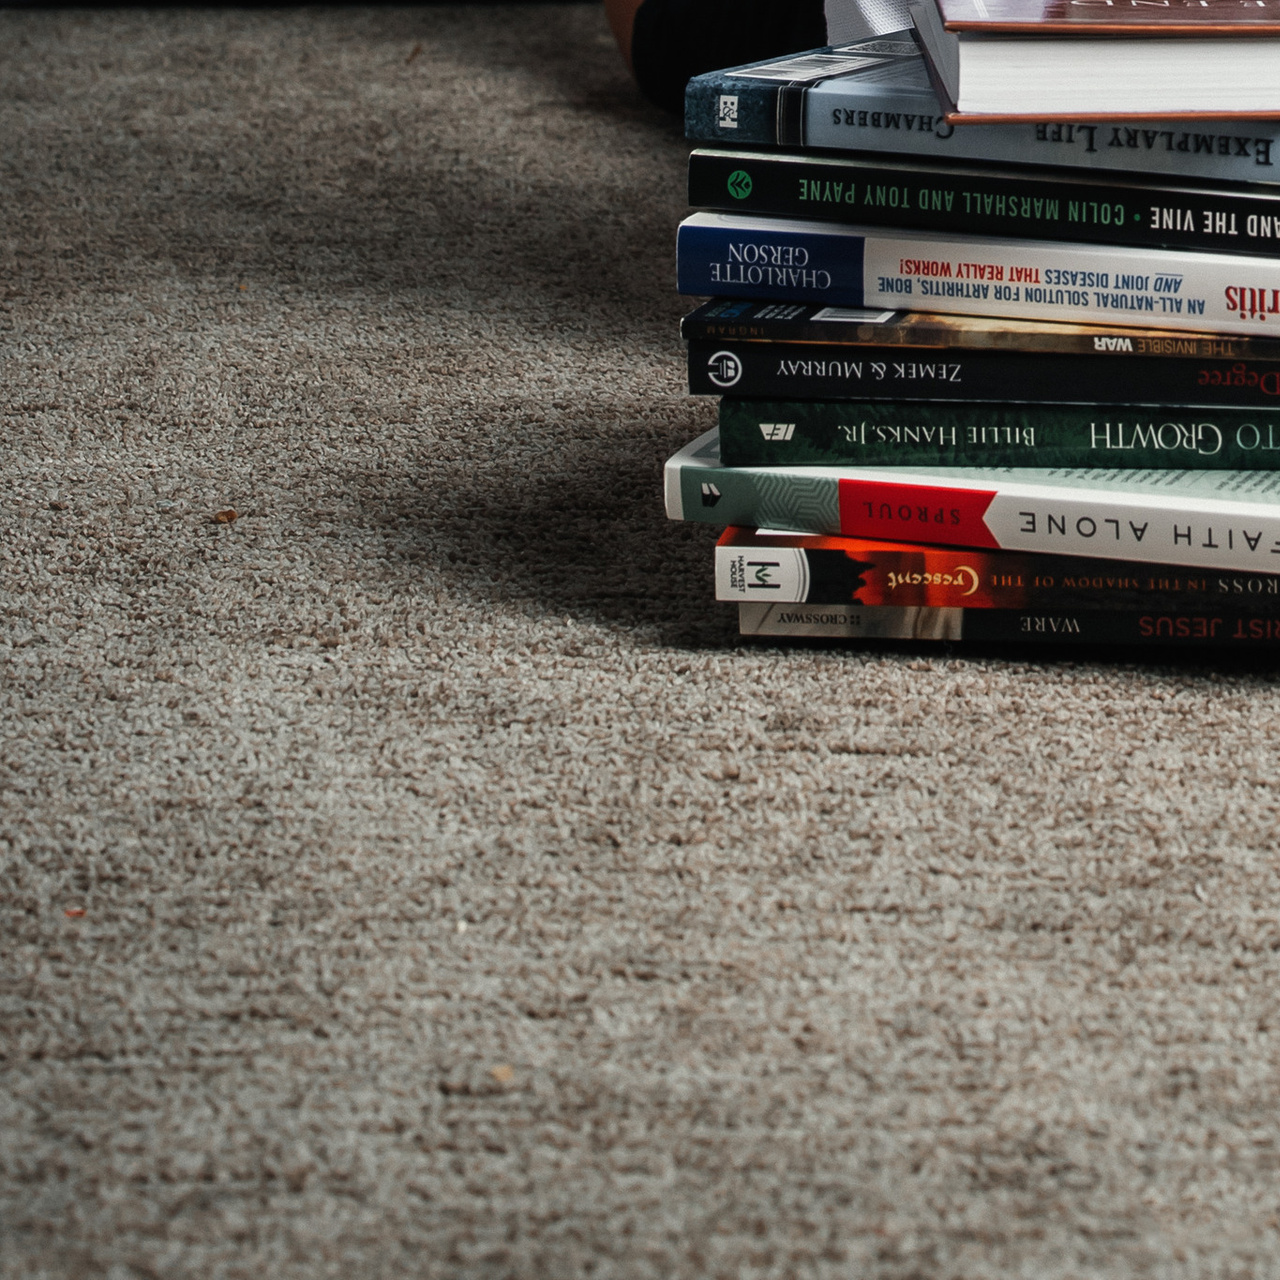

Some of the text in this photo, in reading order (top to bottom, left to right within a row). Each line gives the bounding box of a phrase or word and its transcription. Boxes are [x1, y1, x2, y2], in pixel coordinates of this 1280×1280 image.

[719, 95, 738, 128] B&H
[832, 108, 954, 139] CHAMBERS
[1035, 123, 1274, 166] EXEMPLARY LIFE
[799, 179, 1124, 226] COLIN MARSHALL AND TONY PAYNE
[1150, 207, 1194, 231] VINE
[1203, 211, 1238, 234] THE
[728, 243, 809, 266] GERSON
[709, 262, 831, 289] CHARLOTTE
[899, 259, 1183, 294] AND JOINT DISEASES THAT REALLY WORKS!
[878, 277, 1205, 315] AN ALL-NATURAL SOLUTION FOR ARTHRITIS, BONE
[706, 326, 764, 336] INGRAM
[1094, 337, 1233, 356] THE INVISIBLE WAR
[776, 360, 961, 382] ZEMEK & MURRAY
[1198, 363, 1280, 395] Degree
[837, 421, 867, 444] JR.
[967, 426, 1035, 446] BILLIE
[1090, 422, 1222, 454] GROWTH
[1236, 424, 1280, 450] TO
[863, 501, 960, 525] SPROUL
[1019, 512, 1148, 542] ALONE
[729, 560, 737, 589] HOUSE
[737, 555, 746, 593] HARVEST
[887, 565, 979, 596] Crescent
[990, 575, 1024, 587] THE
[1033, 576, 1054, 588] OF
[1063, 576, 1138, 590] SHADOW
[1149, 578, 1180, 590] THE
[1188, 579, 1206, 591] IN
[777, 612, 847, 625] CROSSWAY
[1019, 615, 1080, 634] WARE
[1139, 616, 1222, 638] JESUS
